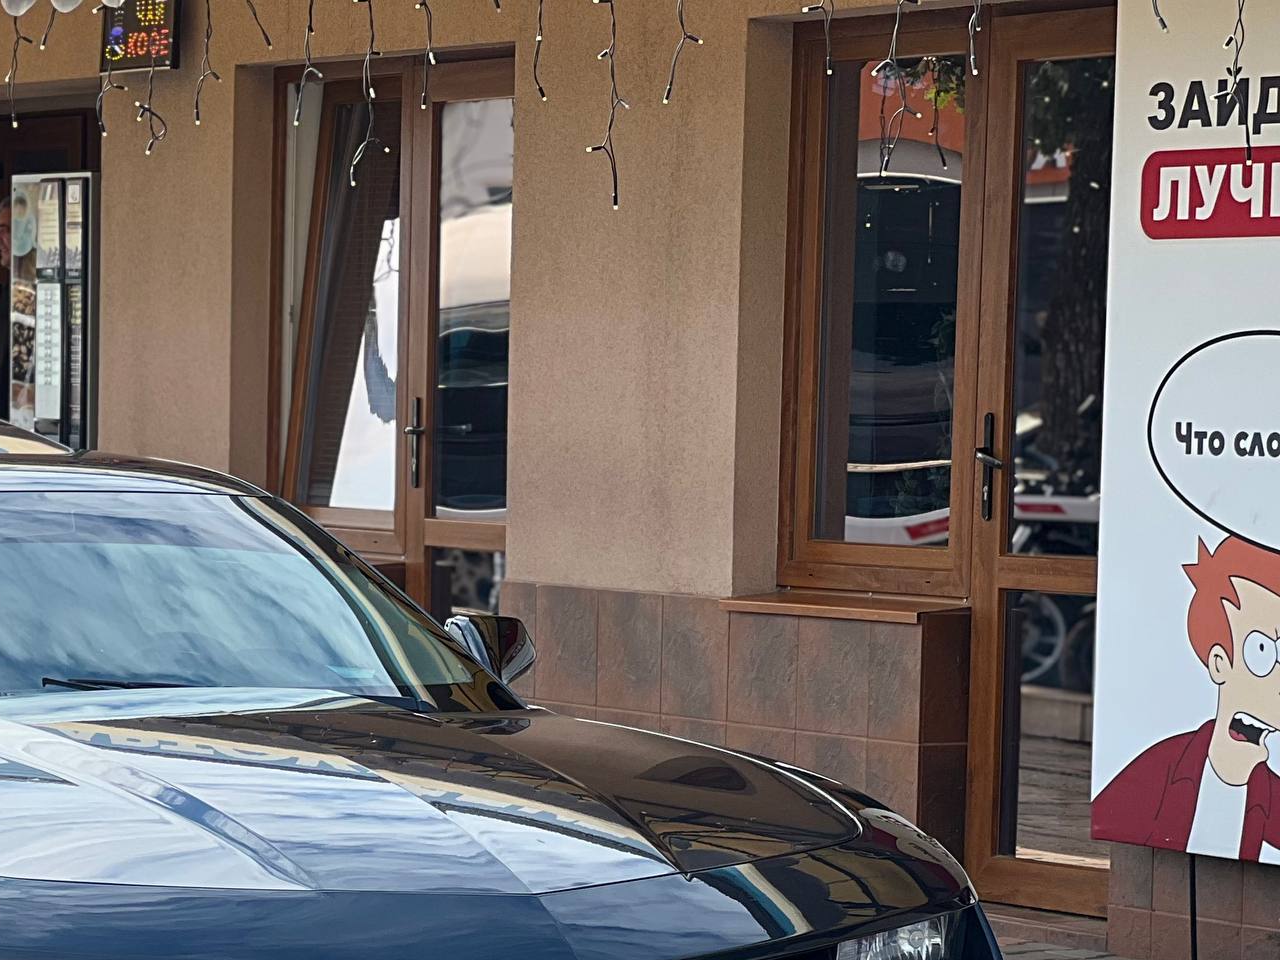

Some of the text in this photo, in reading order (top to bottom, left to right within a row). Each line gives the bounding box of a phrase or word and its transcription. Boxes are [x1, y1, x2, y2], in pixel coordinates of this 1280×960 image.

[1152, 161, 1280, 222] ЛУЧ
[1175, 421, 1280, 458] Что сло
